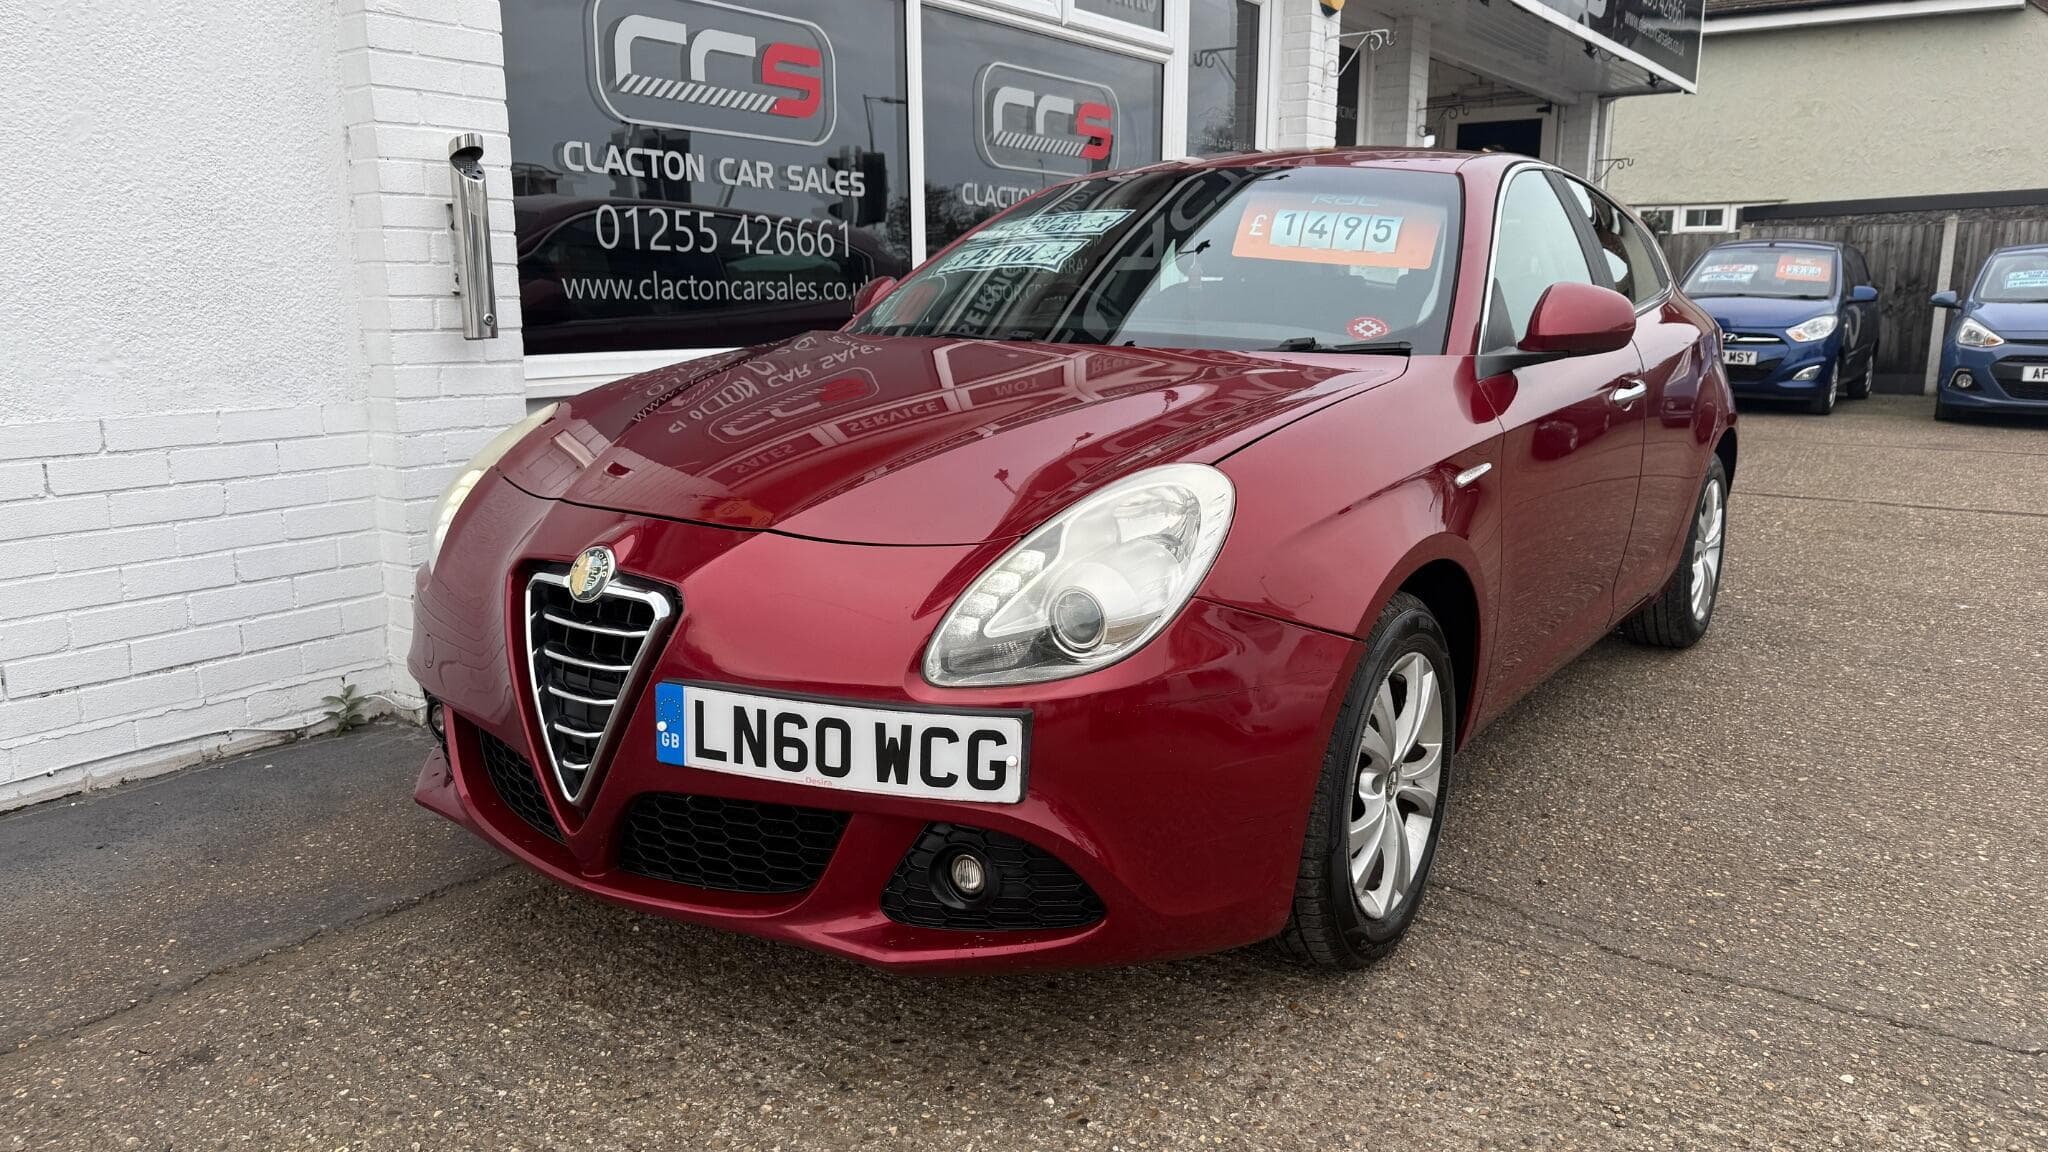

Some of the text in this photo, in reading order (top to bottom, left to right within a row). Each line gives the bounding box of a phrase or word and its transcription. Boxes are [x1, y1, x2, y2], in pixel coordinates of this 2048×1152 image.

[563, 141, 866, 197] CLACTON CAR SALES
[595, 204, 851, 258] 01255 426661
[1729, 351, 1753, 364] MSY
[661, 731, 680, 748] GB
[695, 699, 1008, 791] LN60 WCG
[805, 776, 833, 787] Desira
